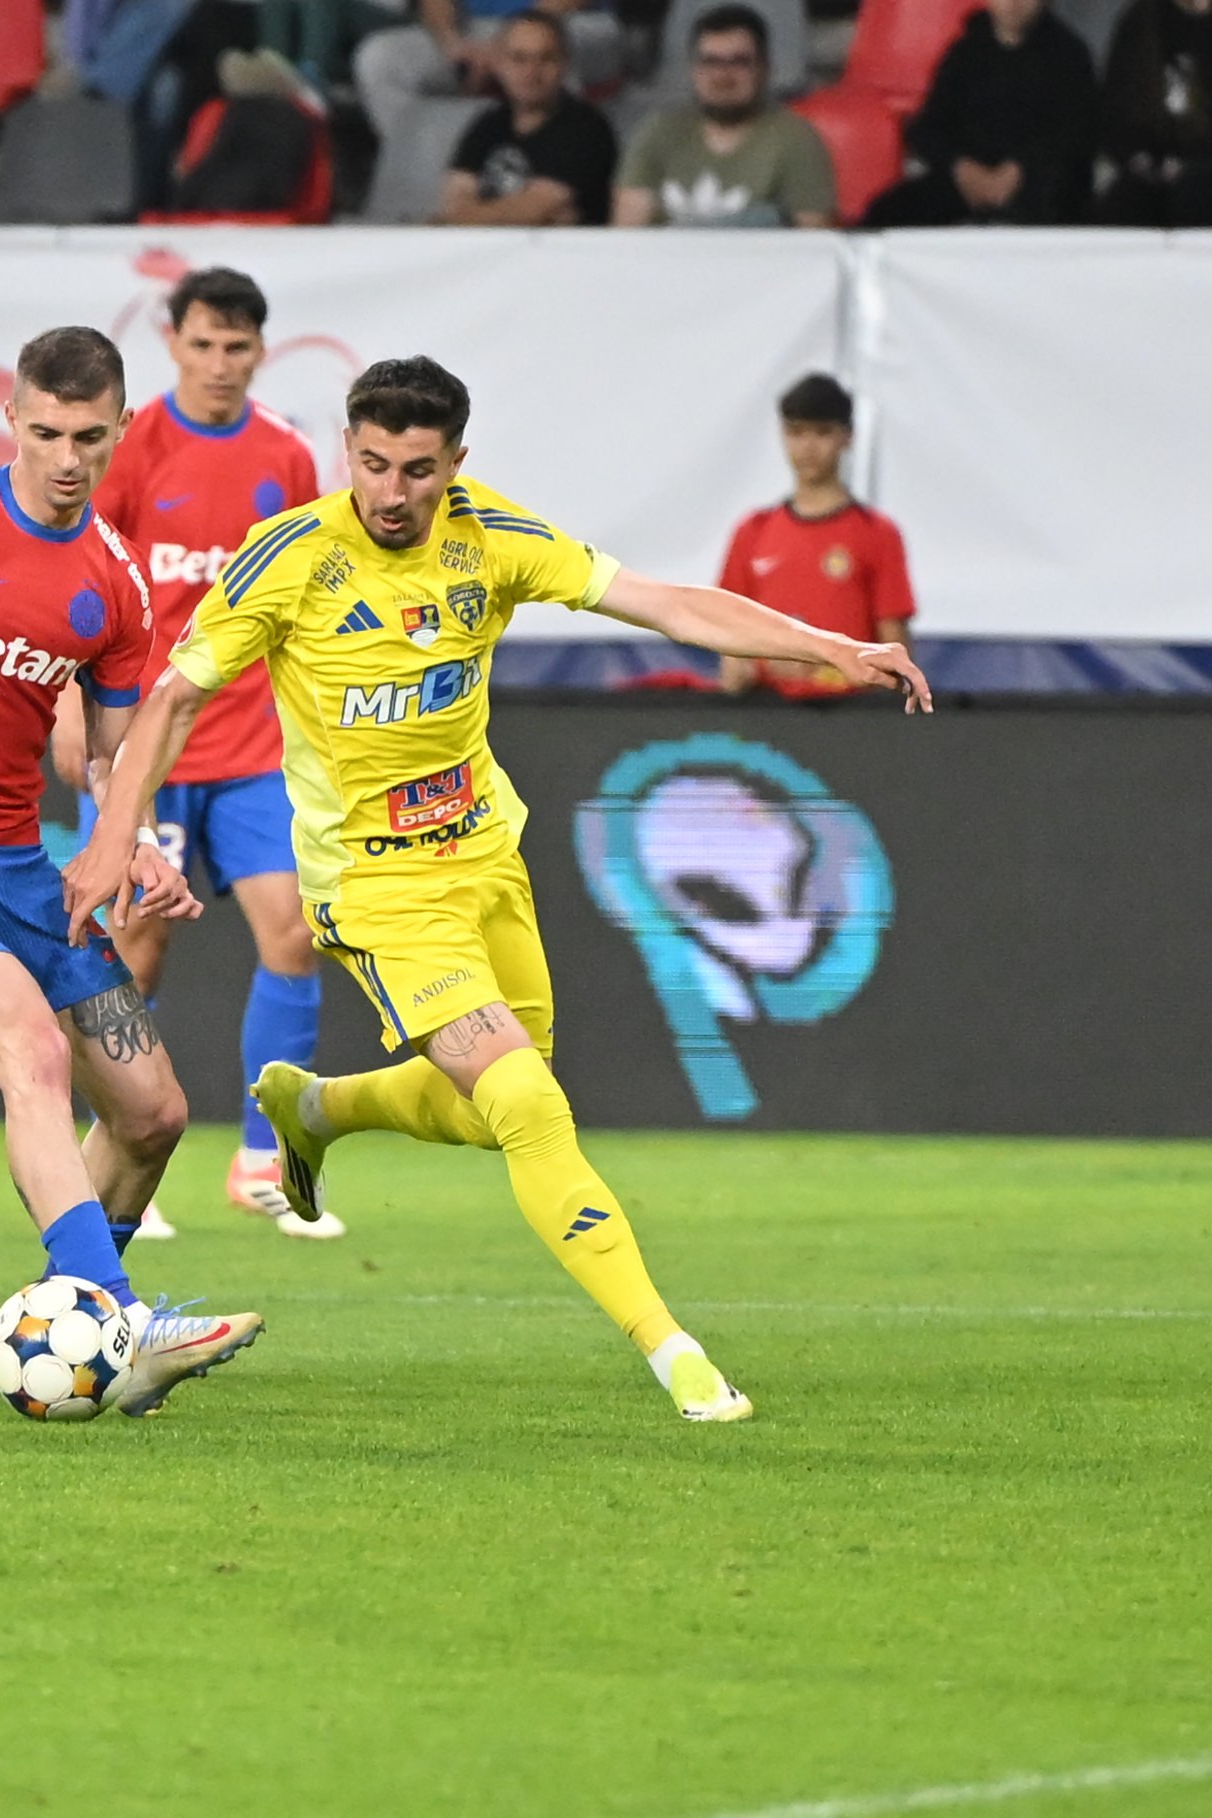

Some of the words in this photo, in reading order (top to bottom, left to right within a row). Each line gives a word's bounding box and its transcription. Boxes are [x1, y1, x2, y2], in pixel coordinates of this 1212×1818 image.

[149, 543, 237, 586] Bet
[313, 543, 347, 586] SARAAC
[325, 558, 357, 595] IMPX
[398, 799, 463, 828] DEPO
[412, 967, 476, 1008] ANDISOL
